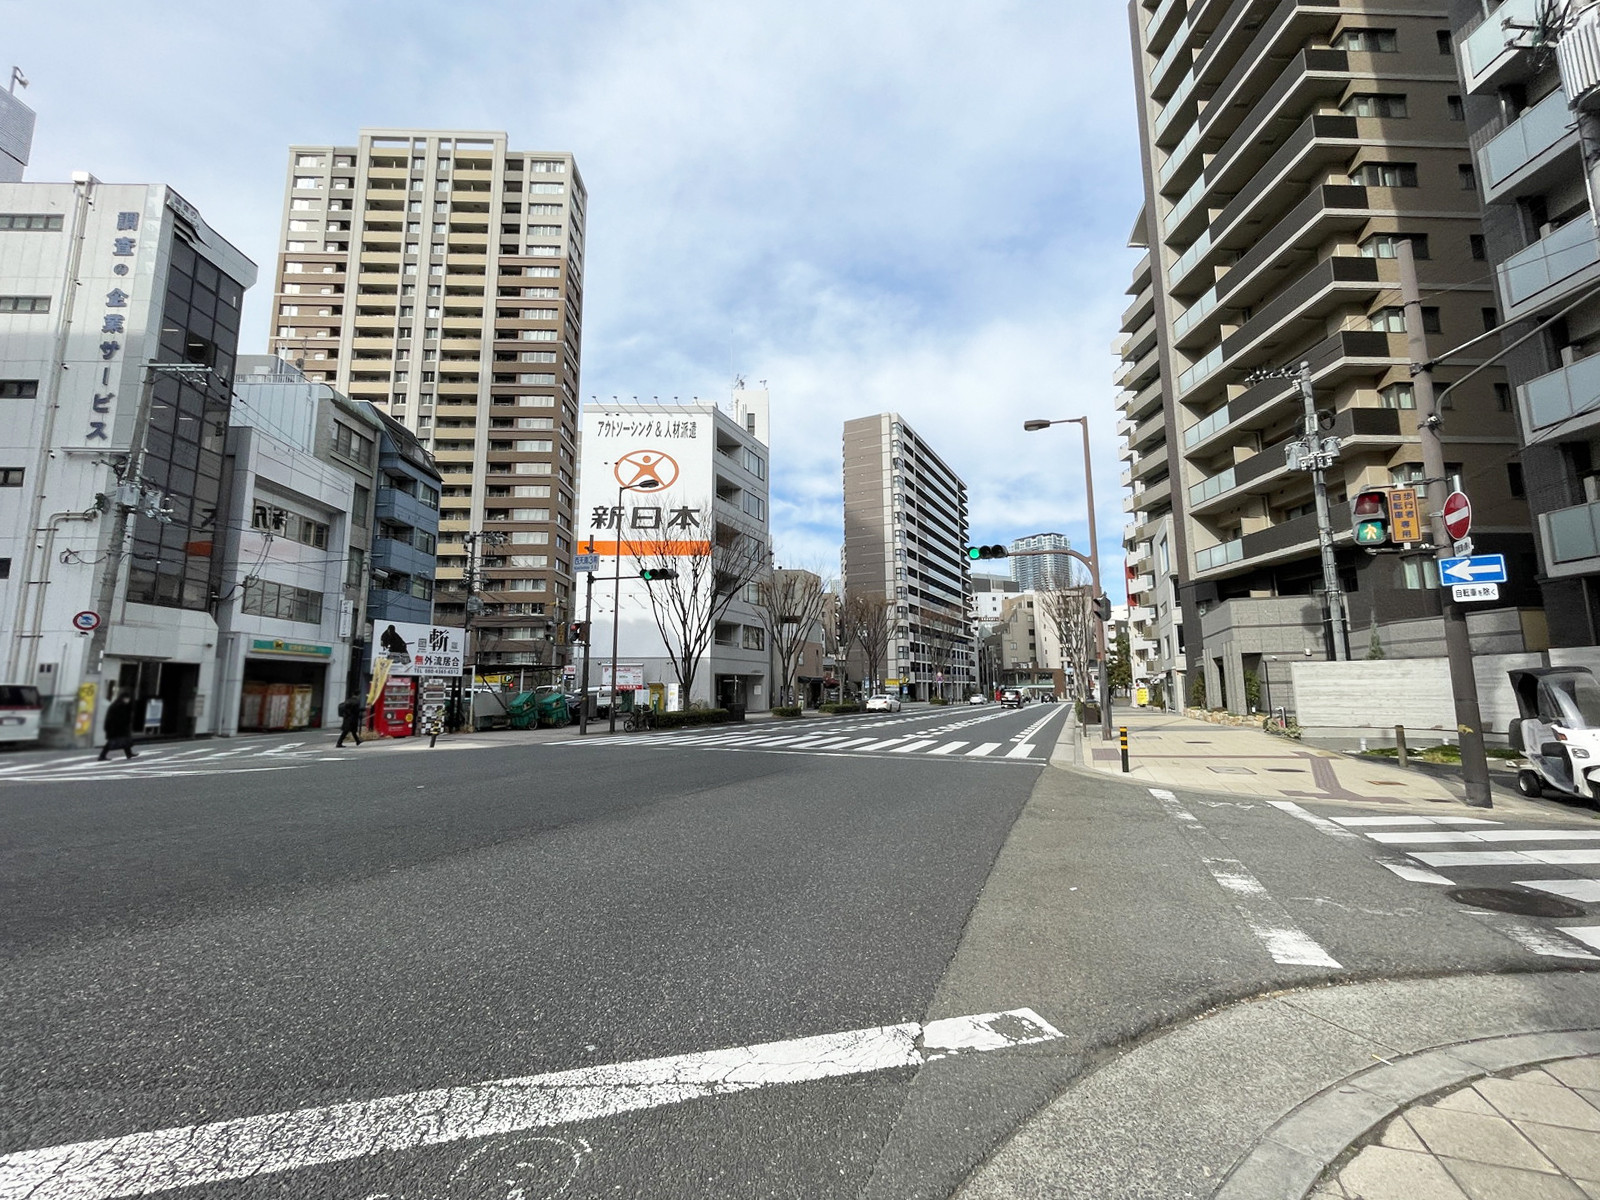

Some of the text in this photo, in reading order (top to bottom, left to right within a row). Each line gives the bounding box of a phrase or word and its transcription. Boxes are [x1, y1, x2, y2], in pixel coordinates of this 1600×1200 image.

[590, 506, 700, 530] 新日本
[1455, 587, 1496, 598] 自転車を除く
[414, 654, 460, 667] 無外流居合
